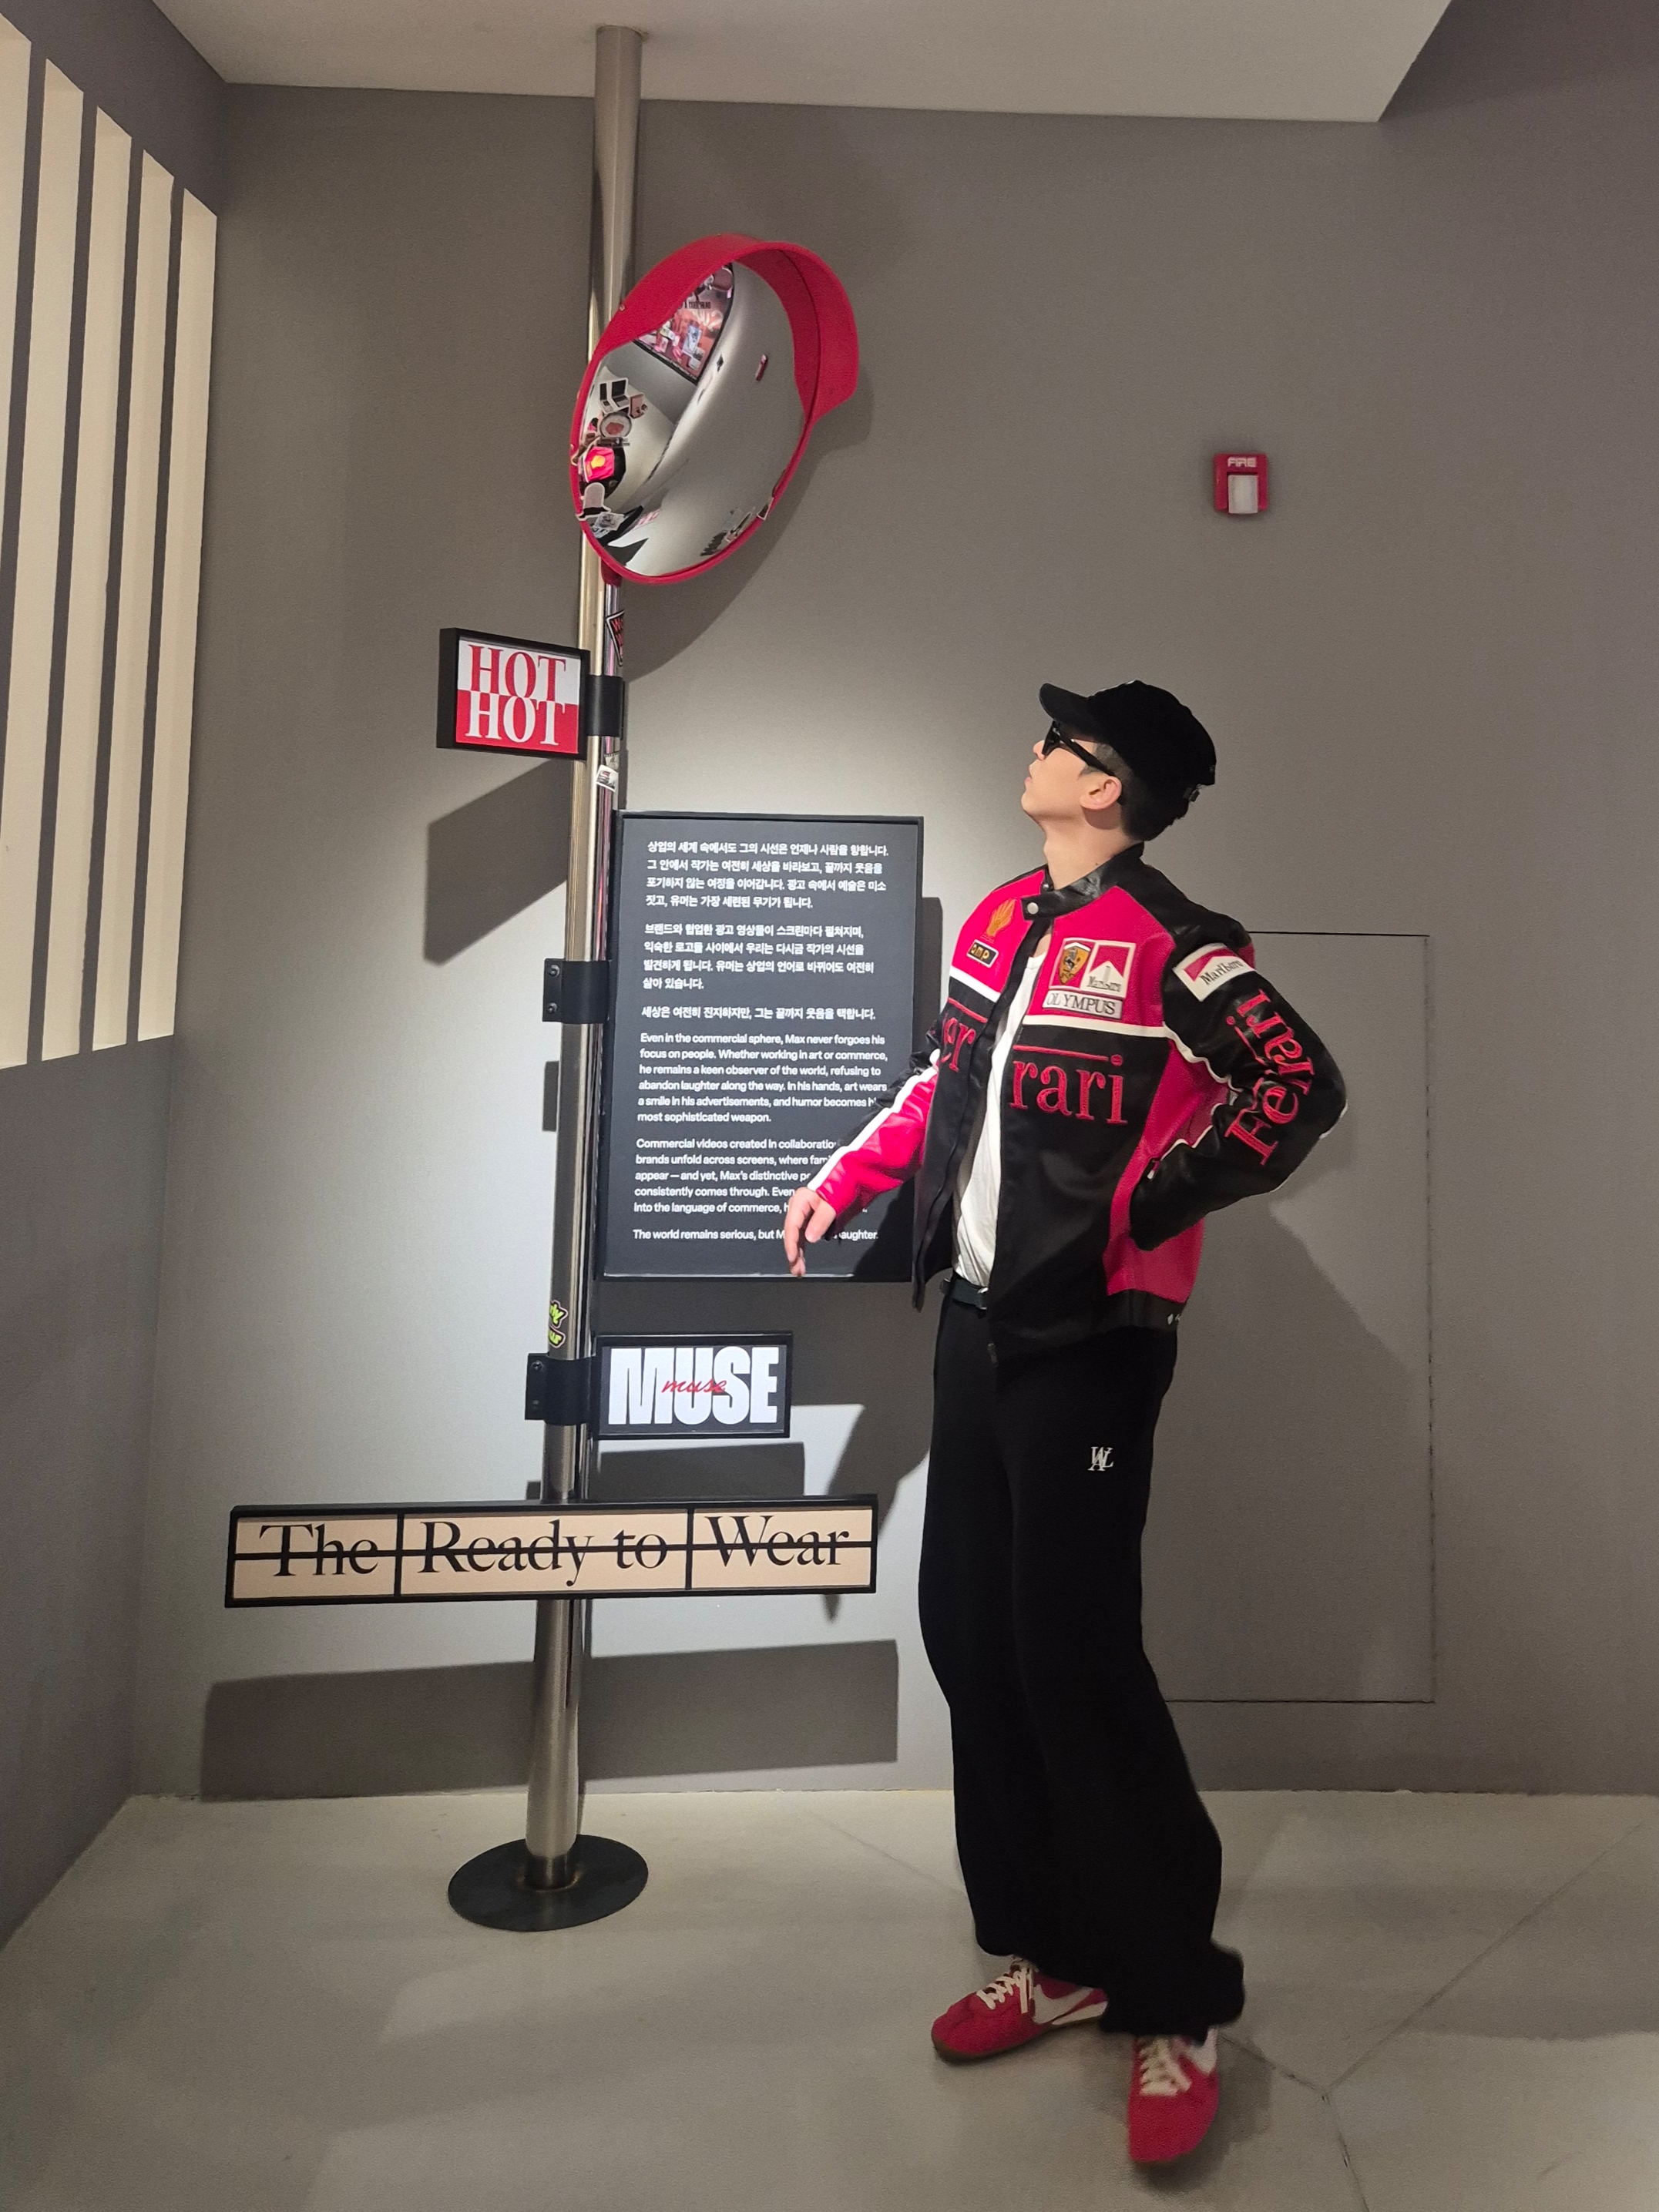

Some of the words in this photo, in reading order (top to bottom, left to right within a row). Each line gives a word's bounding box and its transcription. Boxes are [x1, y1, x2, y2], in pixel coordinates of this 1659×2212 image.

[468, 644, 566, 702] HOT
[465, 690, 566, 746] HOT
[648, 841, 676, 852] 상업의
[678, 841, 697, 853] 세계
[700, 842, 737, 854] 속에서도
[739, 843, 757, 854] 그의
[761, 843, 788, 854] 시선은
[790, 844, 818, 855] 언제나
[820, 844, 848, 855] 사람을
[851, 844, 888, 856] 향합니다.
[647, 860, 657, 869] 그
[660, 859, 688, 871] 안에서
[691, 860, 719, 871] 작가는
[722, 860, 749, 872] 여전히
[751, 861, 781, 872] 세상을
[783, 861, 822, 874] 바라보고,
[825, 862, 852, 874] 끝까지
[855, 863, 882, 874] 웃음을
[646, 877, 683, 888] 포기하지
[737, 878, 784, 890] 이어갑니다.
[787, 879, 805, 891] 광고
[808, 880, 835, 891] 속에서
[838, 880, 865, 891] 예술은
[868, 881, 886, 891] 미소
[646, 895, 667, 907] 짓고,
[670, 895, 698, 907] 유머는
[700, 895, 720, 907] 가장
[753, 896, 781, 908] 무기가
[784, 897, 813, 908] 됩니다.
[645, 923, 683, 935] 브랜드와
[715, 925, 734, 935] 광고
[737, 925, 774, 936] 영상들이
[777, 925, 823, 937] 스크린마다
[675, 942, 703, 953] 로고들
[705, 942, 743, 954] 사이에서
[746, 943, 774, 954] 우리는
[776, 943, 804, 955] 다시금
[807, 944, 834, 955] 작가의
[837, 944, 864, 955] 시선을
[644, 959, 680, 971] 발견하게
[683, 960, 713, 972] 됩니다.
[716, 961, 744, 972] 유머는
[746, 961, 774, 972] 상업의
[777, 961, 804, 972] 언어로
[808, 962, 844, 973] 바뀌어도
[847, 962, 874, 973] 여전히
[643, 978, 663, 989] 살아
[665, 978, 704, 989] 있습니다.
[1046, 992, 1116, 1015] OLYMPUS
[642, 1006, 670, 1018] 세상은
[673, 1006, 700, 1018] 여전히
[704, 1007, 751, 1019] 진지하지만,
[754, 1008, 773, 1019] 그는
[776, 1008, 803, 1019] 끝까지
[806, 1008, 834, 1019] 웃음을
[837, 1009, 875, 1019] 택합니다.
[640, 1033, 663, 1042] Even
[665, 1033, 673, 1042] in
[675, 1033, 691, 1042] the
[693, 1034, 747, 1043] commercial
[749, 1034, 783, 1045] sphere,
[785, 1035, 805, 1043] Max
[835, 1035, 870, 1046] forgoes
[871, 1035, 885, 1044] his
[640, 1048, 667, 1058] focus
[682, 1049, 716, 1060] people.
[718, 1049, 760, 1059] Whether
[761, 1049, 798, 1061] working
[799, 1049, 808, 1059] in
[809, 1051, 822, 1059] art
[835, 1052, 888, 1061] commerce,
[640, 1064, 652, 1074] he
[653, 1065, 692, 1074] remains
[701, 1065, 724, 1074] keen
[726, 1065, 768, 1075] observer
[770, 1065, 780, 1075] of
[782, 1066, 798, 1075] the
[800, 1066, 828, 1076] world,
[831, 1066, 869, 1077] refusing
[871, 1067, 881, 1076] to
[639, 1080, 680, 1089] abandon
[681, 1080, 720, 1092] laughter
[721, 1081, 747, 1092] along
[748, 1081, 764, 1090] the
[765, 1083, 785, 1092] way.
[788, 1082, 796, 1090] In
[798, 1081, 811, 1090] his
[812, 1081, 842, 1092] hands,
[845, 1083, 858, 1091] art
[1010, 1054, 1128, 1124] rari
[646, 1096, 670, 1106] smile
[672, 1096, 680, 1106] in
[682, 1096, 695, 1106] his
[696, 1096, 771, 1107] advertisements,
[774, 1097, 791, 1106] and
[792, 1097, 822, 1106] humor
[824, 1097, 866, 1106] becomes
[638, 1113, 663, 1121] most
[664, 1112, 729, 1123] sophisticated
[731, 1115, 771, 1123] weapon.
[636, 1139, 695, 1148] Commercial
[697, 1139, 728, 1148] videos
[730, 1139, 767, 1148] created
[769, 1140, 777, 1148] in
[636, 1154, 669, 1163] brands
[671, 1154, 701, 1164] unfold
[737, 1157, 777, 1166] screens,
[779, 1155, 808, 1164] where
[700, 1171, 718, 1181] yet,
[749, 1170, 800, 1180] distinctive
[635, 1187, 693, 1197] consistently
[730, 1187, 769, 1197] through.
[634, 1203, 653, 1212] into
[654, 1203, 670, 1212] the
[672, 1203, 715, 1213] language
[717, 1202, 727, 1212] of
[729, 1205, 781, 1213] commerce,
[633, 1230, 651, 1239] The
[653, 1230, 679, 1239] world
[681, 1230, 718, 1239] remains
[720, 1230, 756, 1240] serious,
[758, 1230, 774, 1239] but
[839, 1230, 878, 1240] aughter.
[608, 1346, 779, 1425] MUSE
[661, 1378, 727, 1394] muse
[260, 1522, 379, 1577] The
[418, 1519, 594, 1586] Ready
[614, 1529, 667, 1569] to
[704, 1514, 850, 1568] Wear
